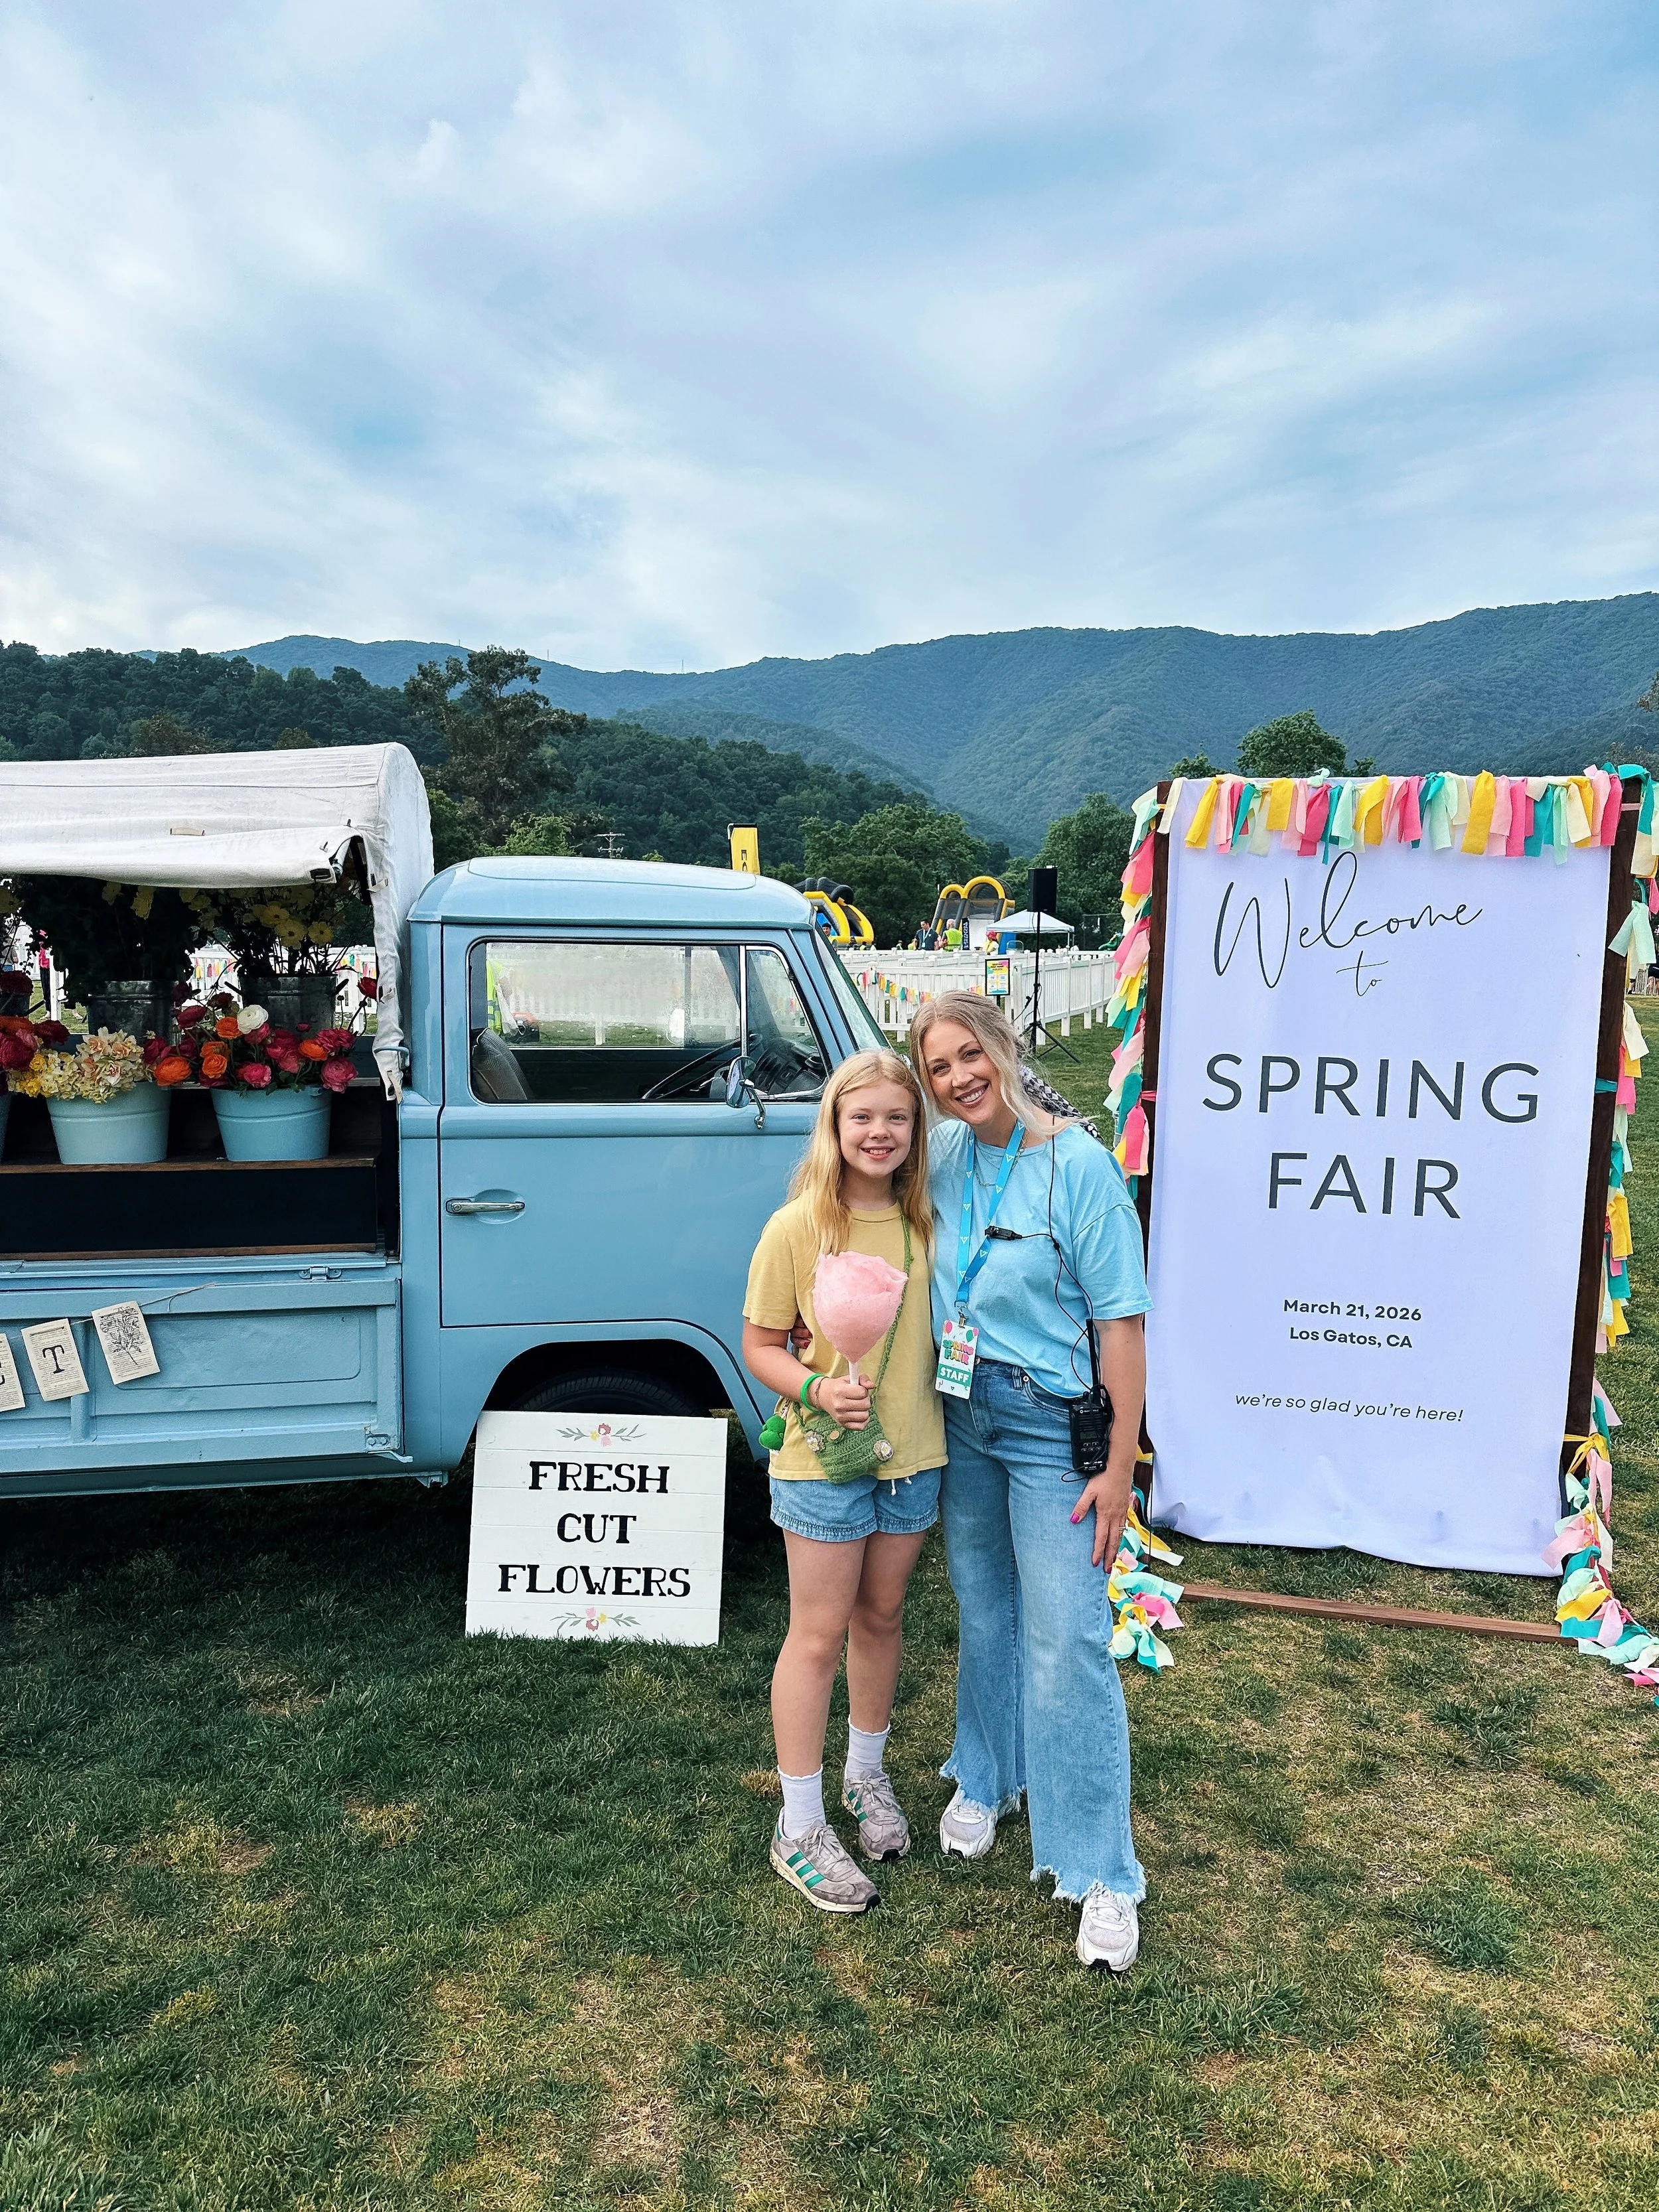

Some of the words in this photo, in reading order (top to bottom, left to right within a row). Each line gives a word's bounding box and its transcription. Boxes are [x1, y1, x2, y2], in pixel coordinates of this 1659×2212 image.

[1214, 851, 1483, 989] Welcome
[1336, 950, 1389, 997] to
[1202, 1053, 1540, 1124] SPRING
[1268, 1152, 1461, 1219] FAIR
[1283, 1299, 1340, 1315] March
[1346, 1303, 1370, 1320] 21,
[1374, 1305, 1421, 1321] 2026
[942, 1339, 974, 1355] SPRING
[1289, 1327, 1319, 1341] Los
[1323, 1329, 1382, 1349] Gatos,
[1386, 1334, 1413, 1349] CA
[944, 1349, 970, 1365] FAIR
[940, 1367, 969, 1382] STAFF
[1236, 1394, 1281, 1408] we're
[1285, 1398, 1306, 1408] so
[1310, 1397, 1351, 1413] glad
[1353, 1403, 1411, 1418] you're
[1415, 1405, 1464, 1422] here!
[528, 1461, 670, 1494] FRESH
[557, 1512, 637, 1544] CUT
[497, 1564, 691, 1597] FLOWERS
